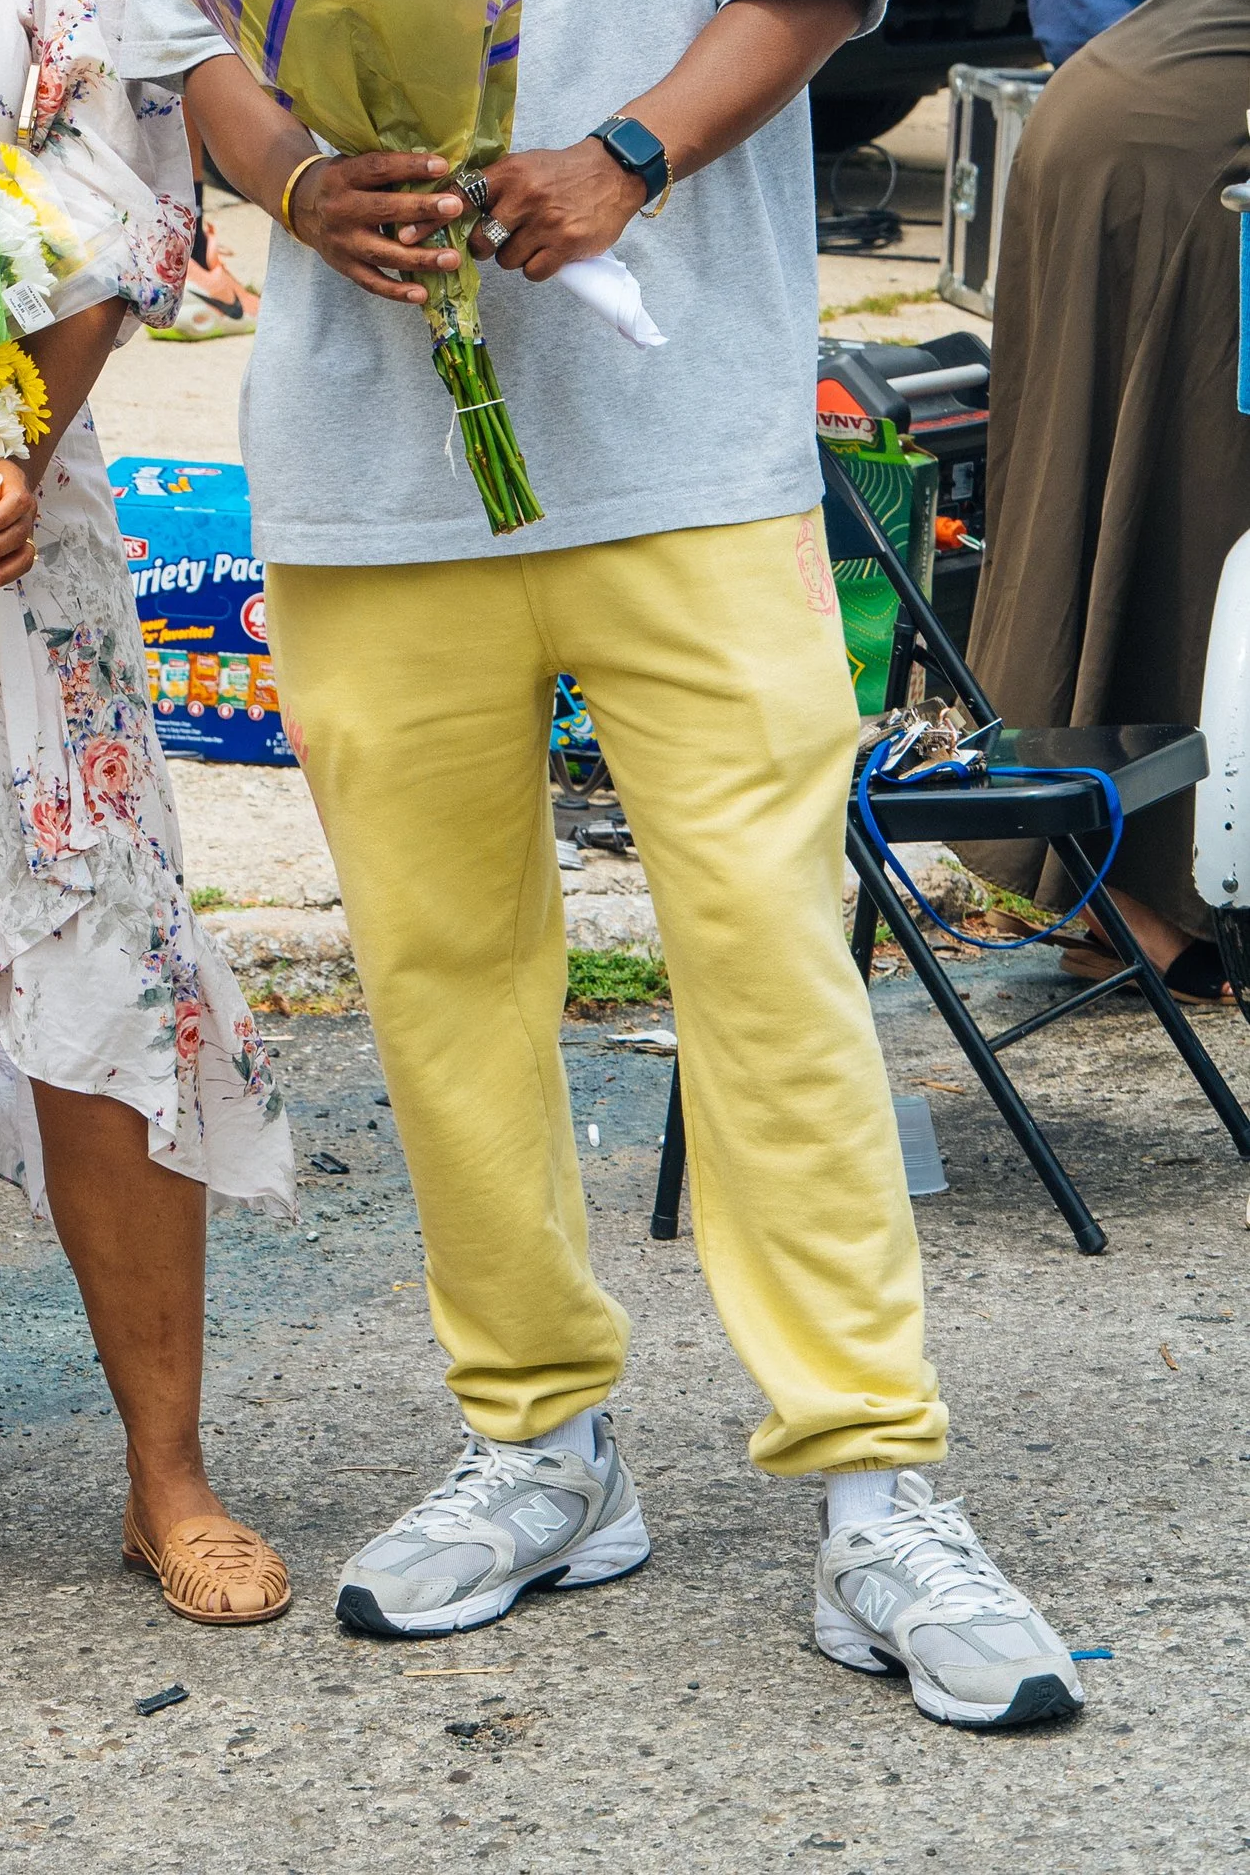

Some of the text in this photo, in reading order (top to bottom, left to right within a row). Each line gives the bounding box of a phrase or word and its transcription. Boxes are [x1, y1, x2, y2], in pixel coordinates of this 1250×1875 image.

[817, 412, 876, 434] CANA
[131, 552, 266, 598] riety Pac
